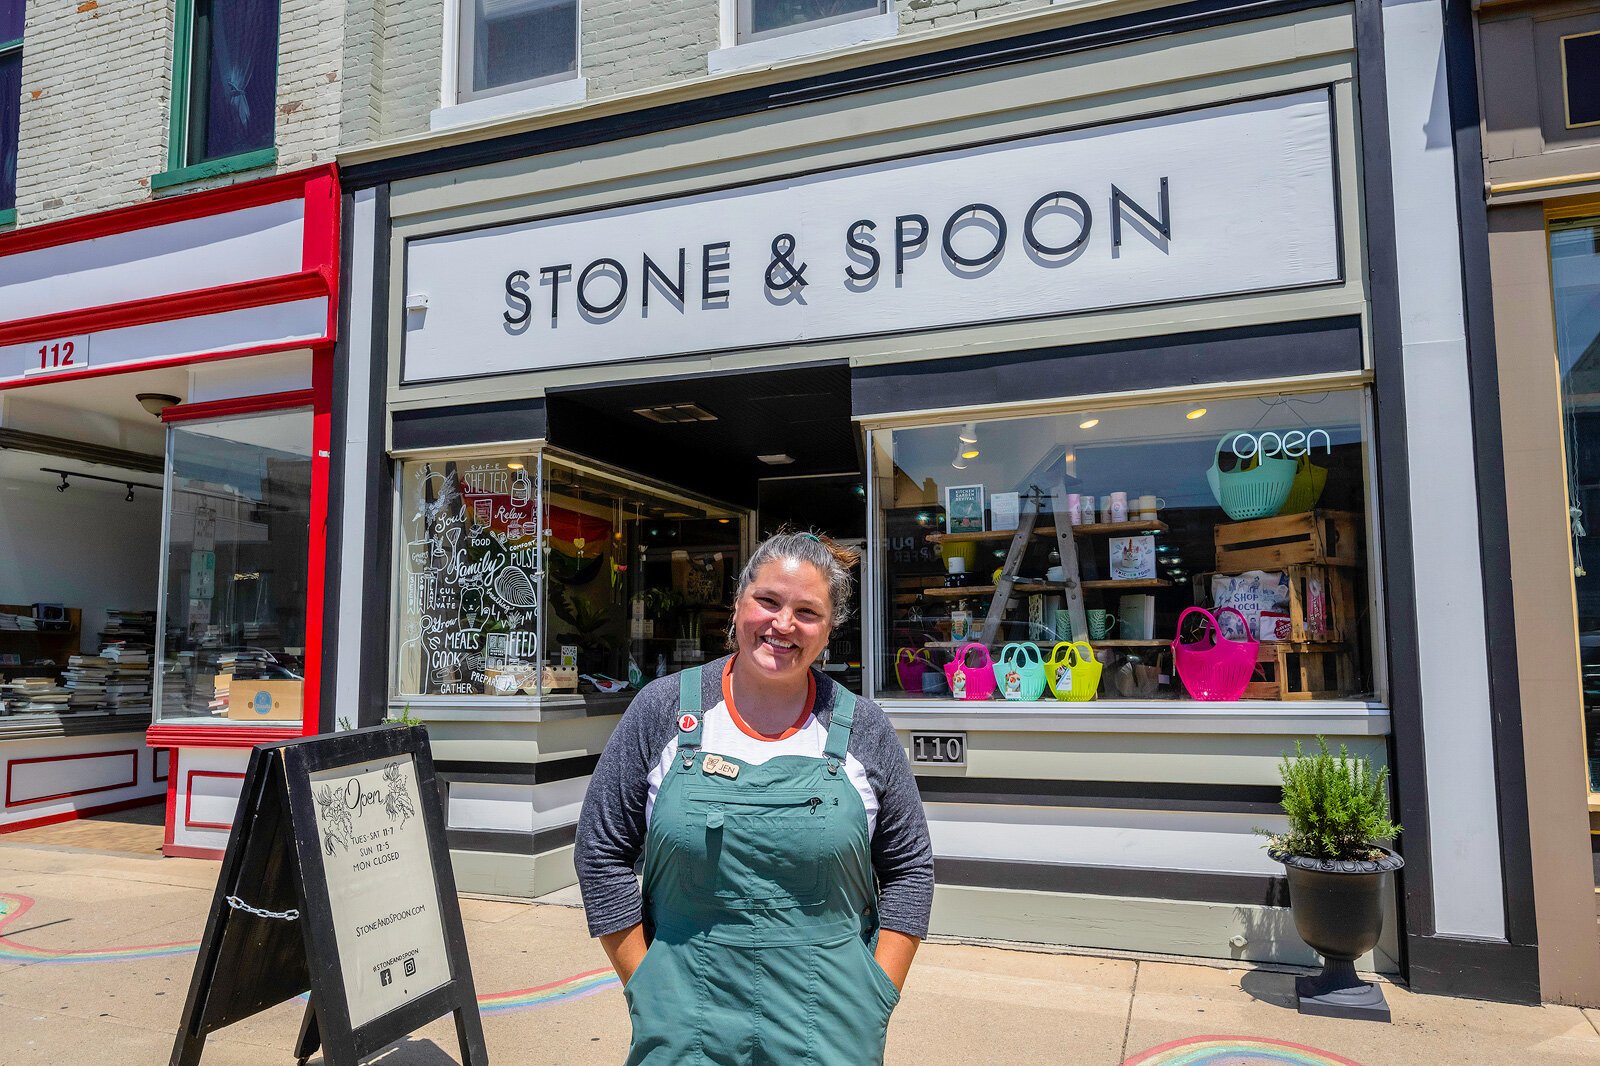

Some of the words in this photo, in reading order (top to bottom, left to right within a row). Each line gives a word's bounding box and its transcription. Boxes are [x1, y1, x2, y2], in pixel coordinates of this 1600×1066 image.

[503, 241, 731, 324] STONE
[765, 233, 809, 290] &
[845, 176, 1171, 281] SPOON
[39, 341, 74, 369] 112
[1232, 429, 1331, 466] open
[464, 472, 508, 494] SHELTER
[435, 504, 467, 533] Soul
[494, 505, 526, 523] Relax
[471, 538, 490, 547] FOOD
[439, 587, 456, 595] CUL
[1233, 592, 1259, 603] SHOP
[445, 632, 480, 650] MEALS
[509, 631, 537, 657] FEED
[432, 650, 462, 668] COOK
[440, 683, 473, 695] GATHER
[916, 737, 960, 760] 110
[719, 763, 735, 774] JEN
[345, 778, 383, 818] Open
[360, 846, 373, 857] SUN
[376, 841, 390, 853] 12-5
[353, 861, 371, 872] MON
[373, 851, 400, 866] CLOSED
